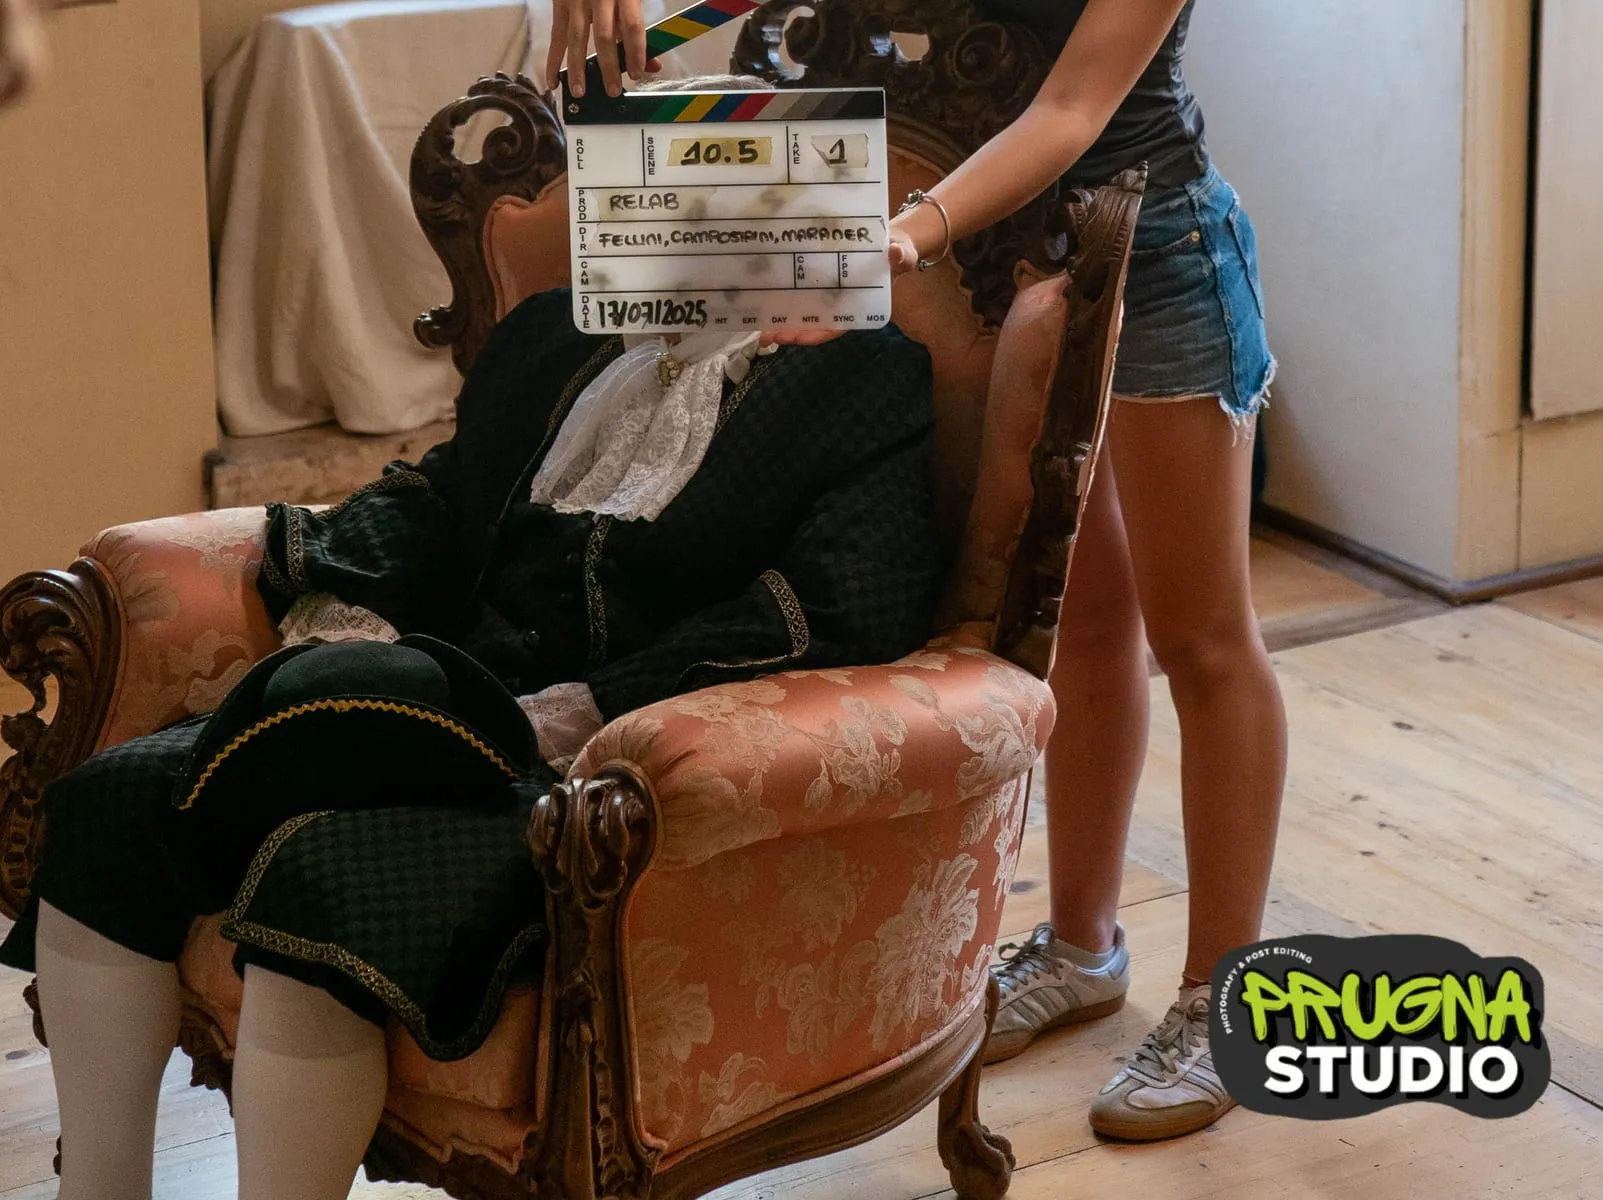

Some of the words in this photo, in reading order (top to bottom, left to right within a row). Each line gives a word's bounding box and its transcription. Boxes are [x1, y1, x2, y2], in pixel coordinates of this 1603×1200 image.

[576, 138, 584, 170] ROLL
[647, 136, 655, 176] SCENE
[680, 139, 759, 166] 10.5
[792, 133, 800, 165] TAKE
[829, 138, 848, 164] 1
[578, 189, 587, 221] PROD
[609, 192, 680, 212] RELAB
[579, 227, 587, 251] DIR
[580, 261, 589, 286] CAM
[797, 255, 805, 280] CAM
[581, 295, 590, 328] DATE
[596, 298, 708, 330] 17/07/2025
[715, 317, 728, 325] INT
[742, 316, 758, 325] EXT
[771, 316, 788, 325] DAY
[802, 315, 820, 323] NITE
[833, 314, 855, 323] SYNC
[866, 314, 885, 322] MOS
